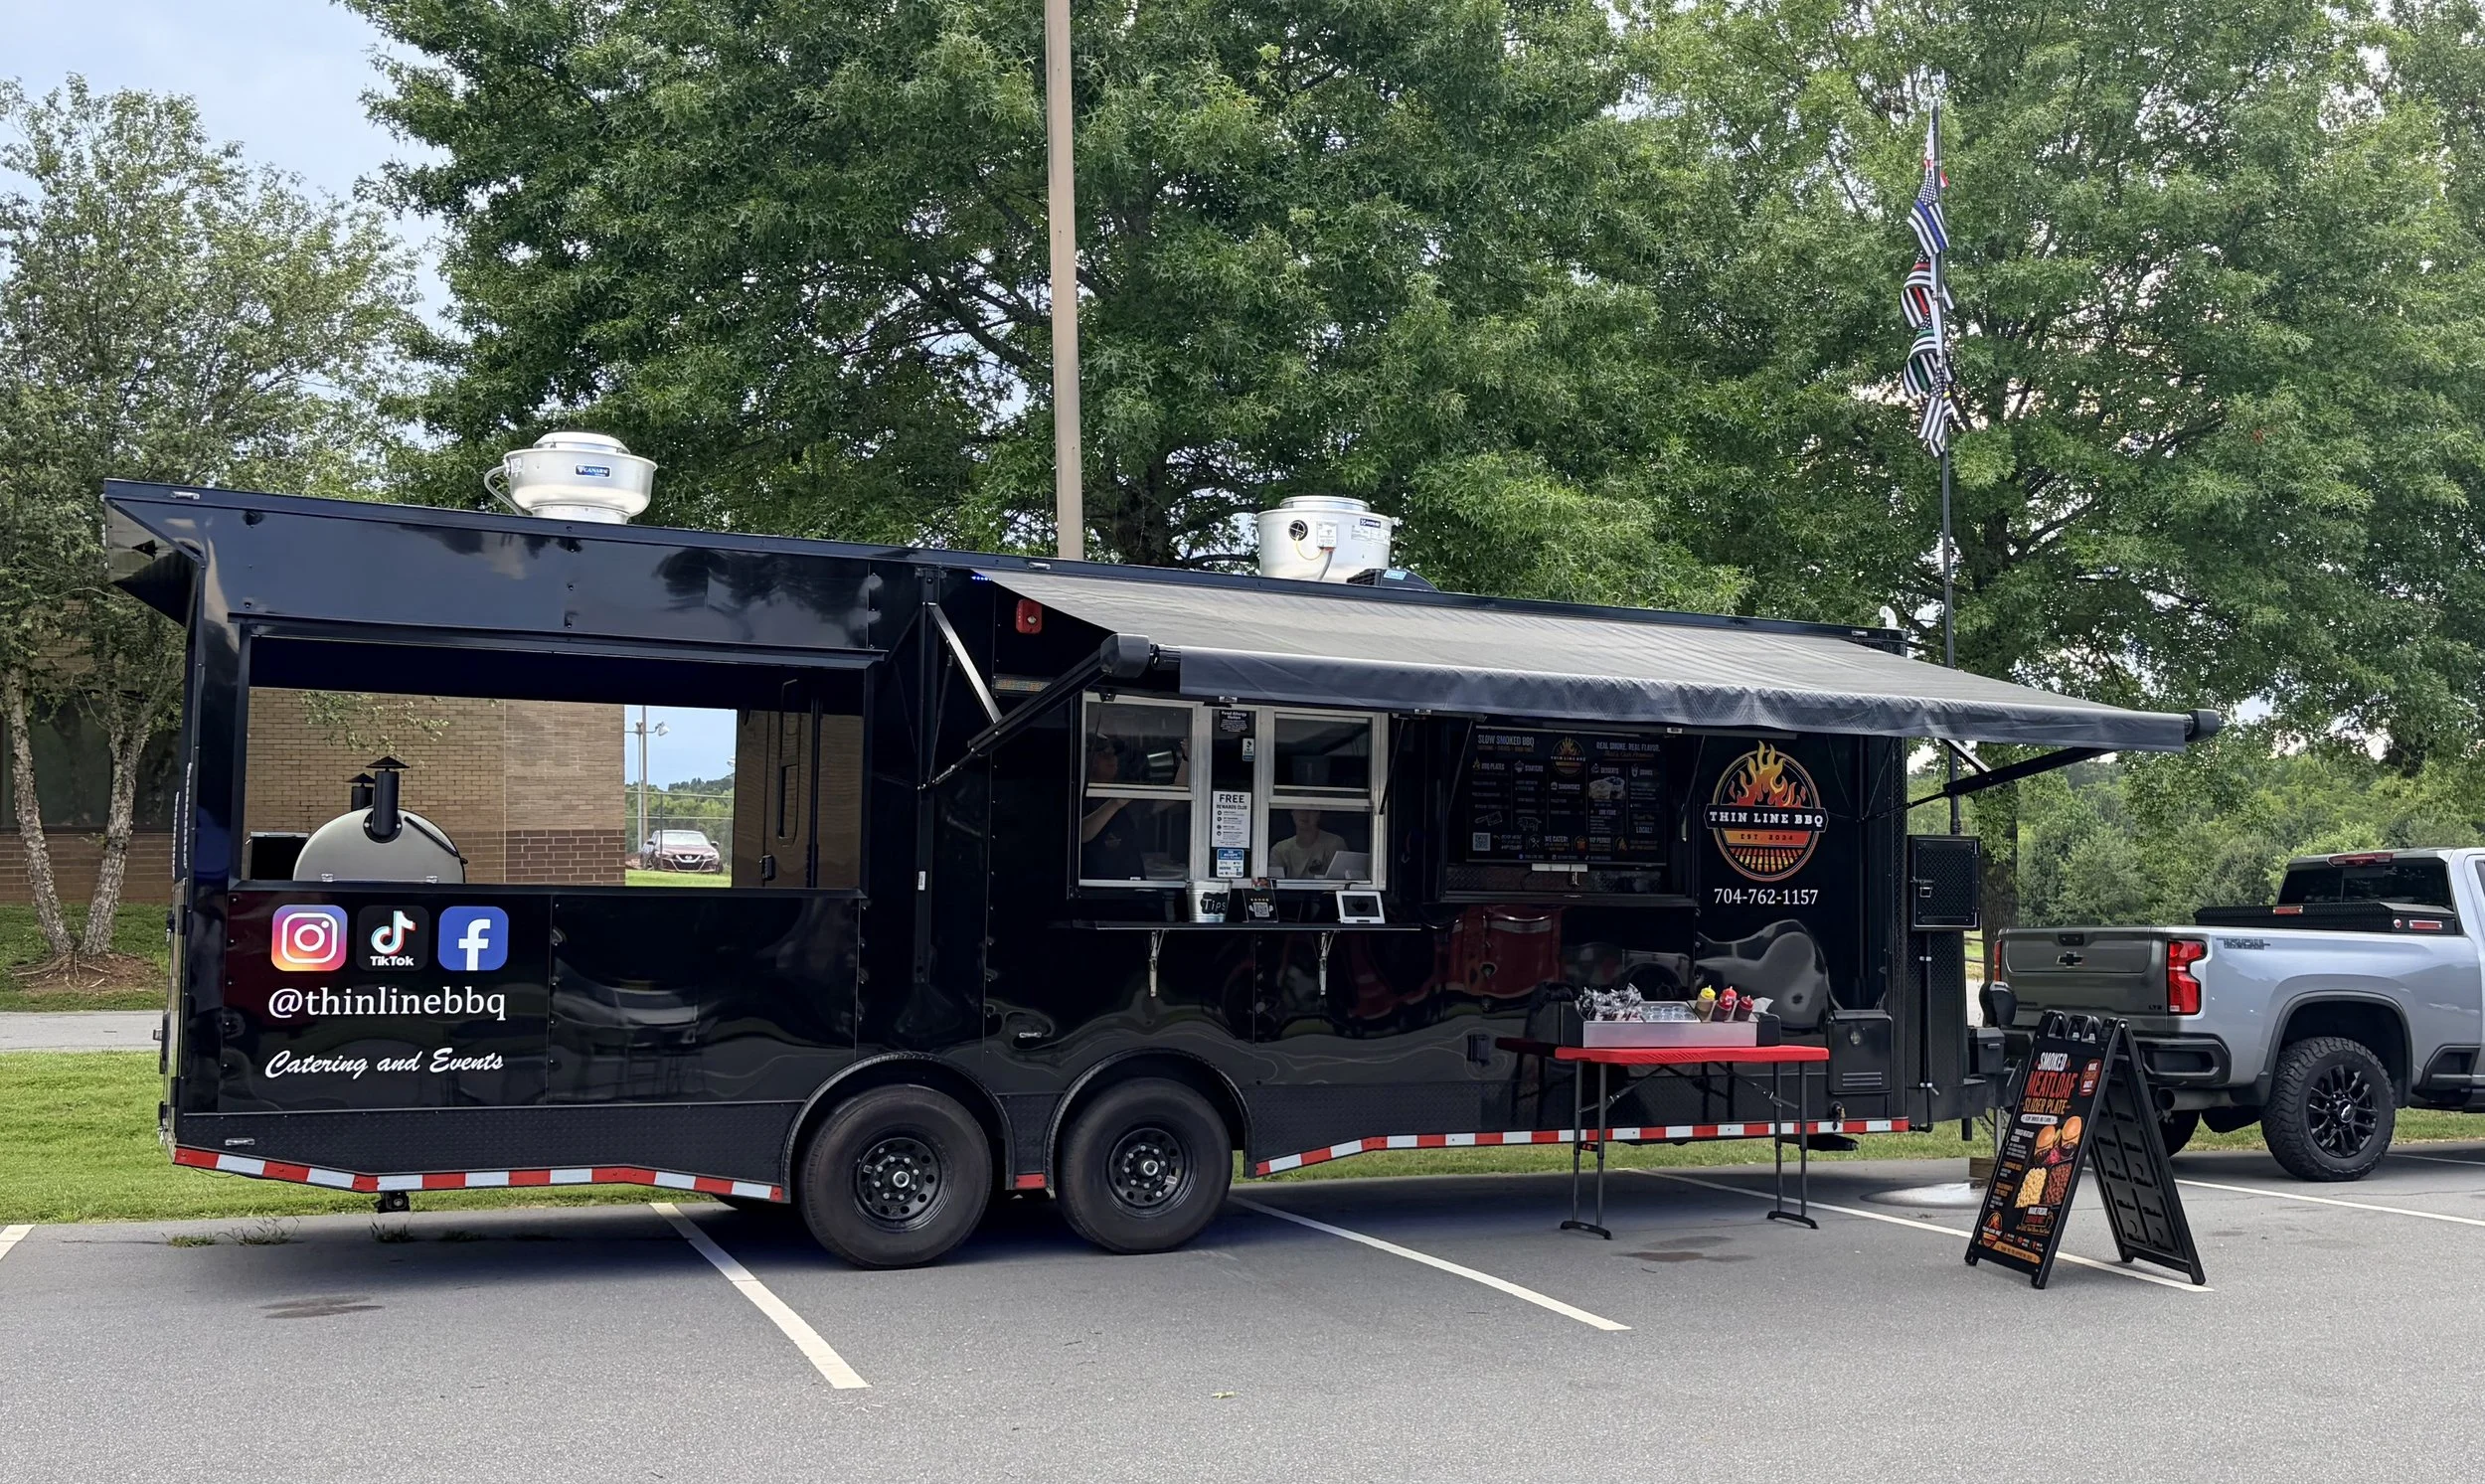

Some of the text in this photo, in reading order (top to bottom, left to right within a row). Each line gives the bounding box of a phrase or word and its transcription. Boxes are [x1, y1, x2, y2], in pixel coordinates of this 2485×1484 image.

[1477, 734, 1535, 747] SLOW SMOKED BBQ
[1219, 794, 1244, 803] FREE
[1710, 811, 1823, 827] THIN LINE BBQ
[1203, 899, 1226, 911] Tips
[1714, 888, 1819, 905] 704-762-1157
[370, 956, 414, 967] TikTok
[268, 986, 506, 1021] @thinlinebbq
[264, 1048, 503, 1079] Catering and Events
[2038, 1052, 2069, 1072] SMOKED
[2026, 1071, 2078, 1098] MEATLOAF
[2023, 1097, 2069, 1115] SLIDER PLATE
